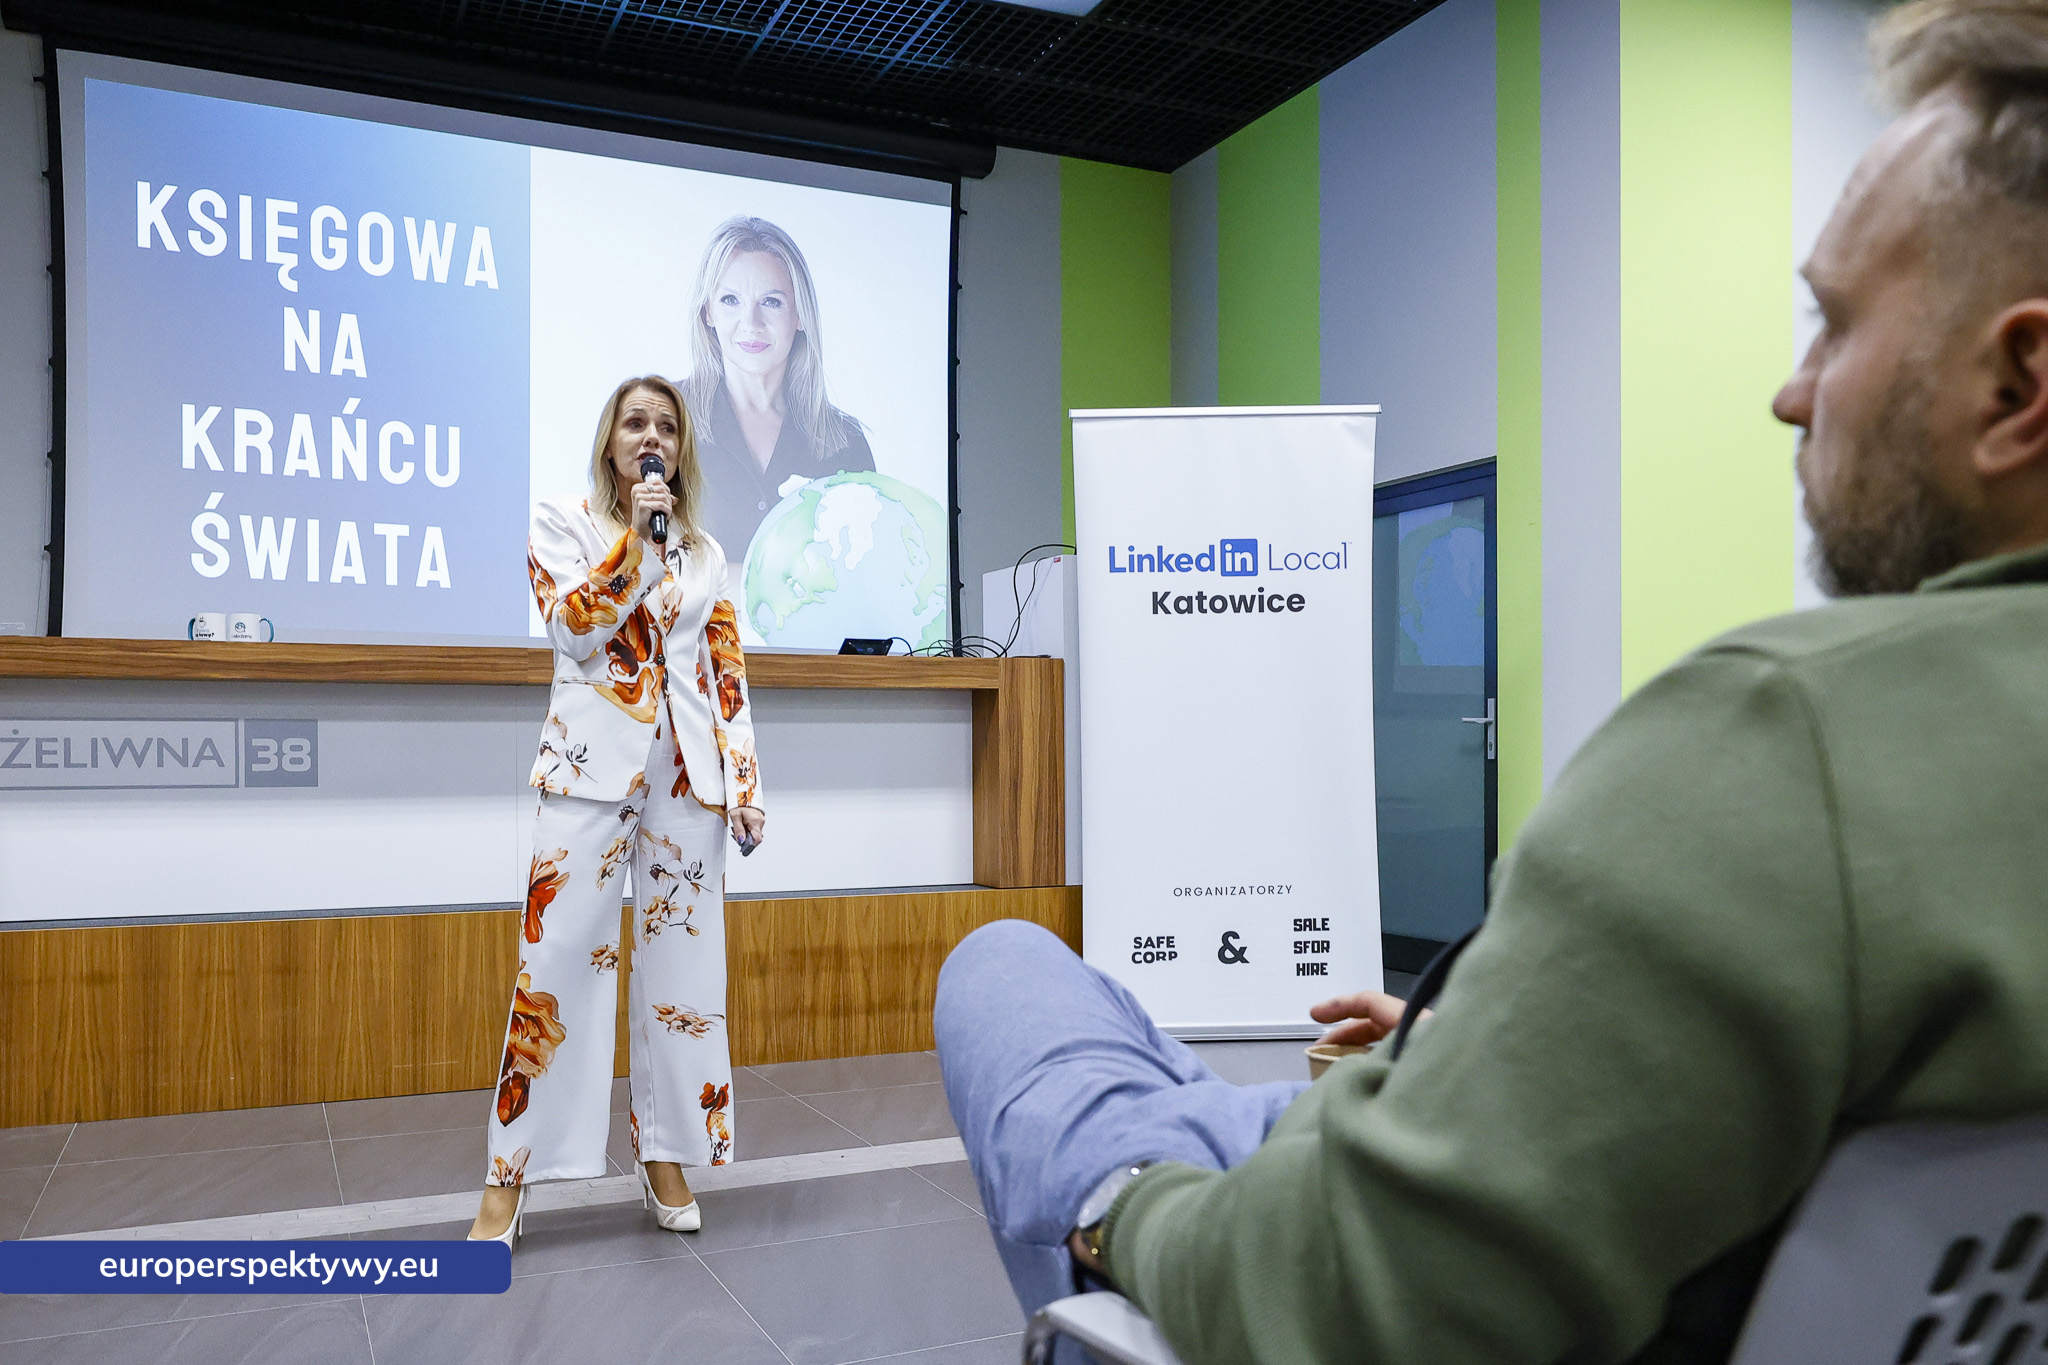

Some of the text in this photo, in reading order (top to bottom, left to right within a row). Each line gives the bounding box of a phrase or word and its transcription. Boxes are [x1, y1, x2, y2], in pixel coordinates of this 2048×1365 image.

[136, 180, 500, 293] KSIĘGOWA
[283, 306, 368, 378] NA
[181, 397, 461, 488] KRAŃCU
[190, 492, 453, 589] ŚWIATA
[1268, 542, 1348, 571] Local
[1152, 586, 1306, 615] Katowice
[0, 728, 312, 772] ŻELIWNA 38
[1173, 885, 1293, 897] ORGANIZATORZY
[1293, 917, 1330, 932] SALE
[1131, 950, 1178, 964] CORP
[1133, 936, 1176, 949] SAFE
[1217, 930, 1250, 965] &
[1293, 940, 1331, 954] SFOR
[1296, 962, 1329, 977] HIRE
